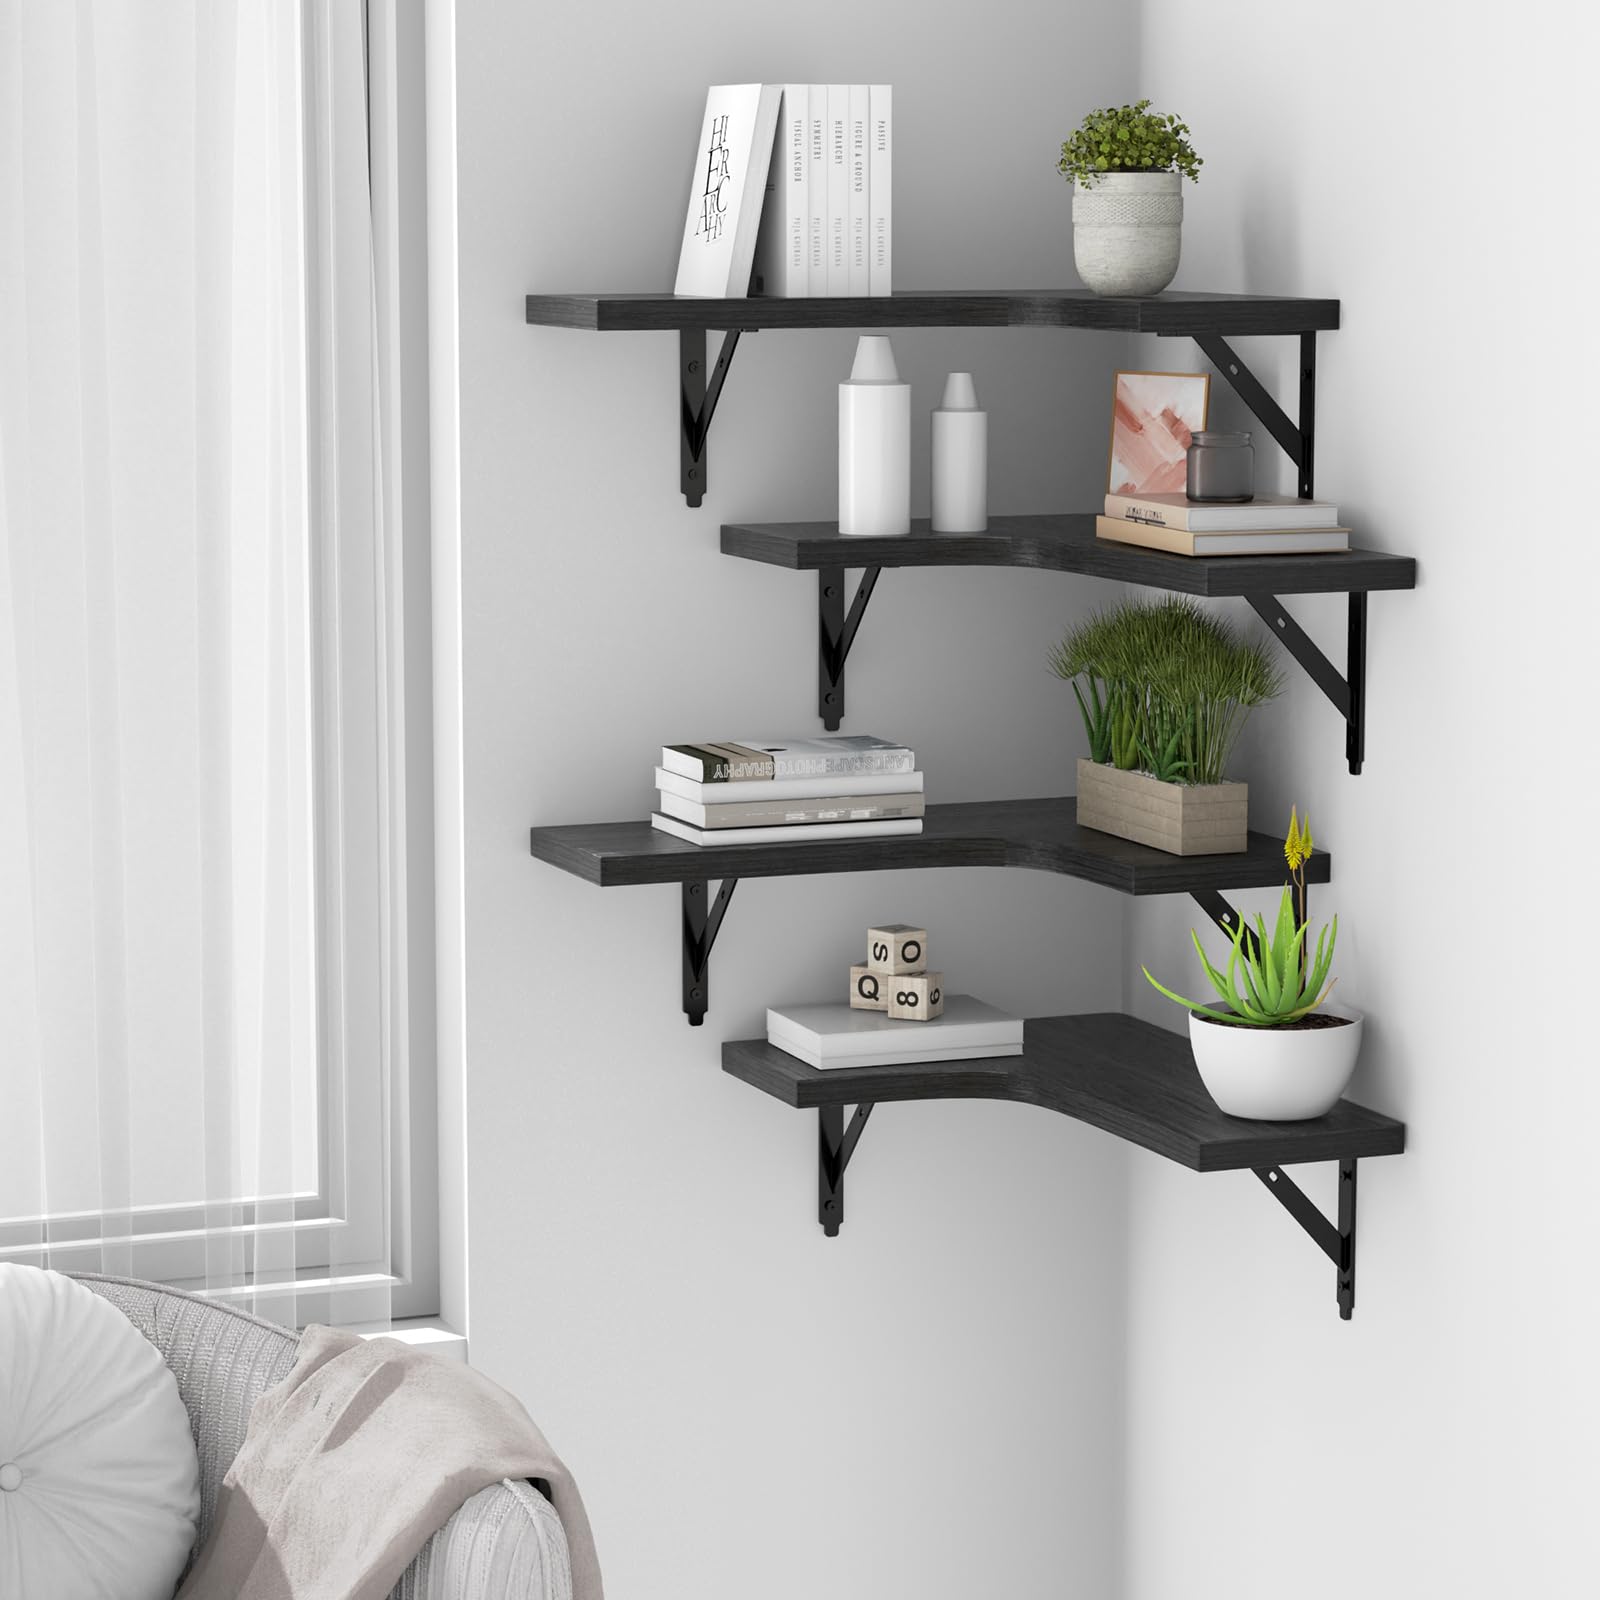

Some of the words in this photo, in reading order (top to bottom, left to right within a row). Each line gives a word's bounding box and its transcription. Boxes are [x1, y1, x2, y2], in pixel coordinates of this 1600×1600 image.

[794, 120, 802, 147] VISUAL
[813, 120, 821, 161] SYMMETRY
[878, 120, 886, 151] PASSIVE
[794, 151, 802, 183] ANCHOR
[873, 942, 888, 962] S
[858, 975, 879, 1001] Q
[896, 991, 919, 1007] 8
